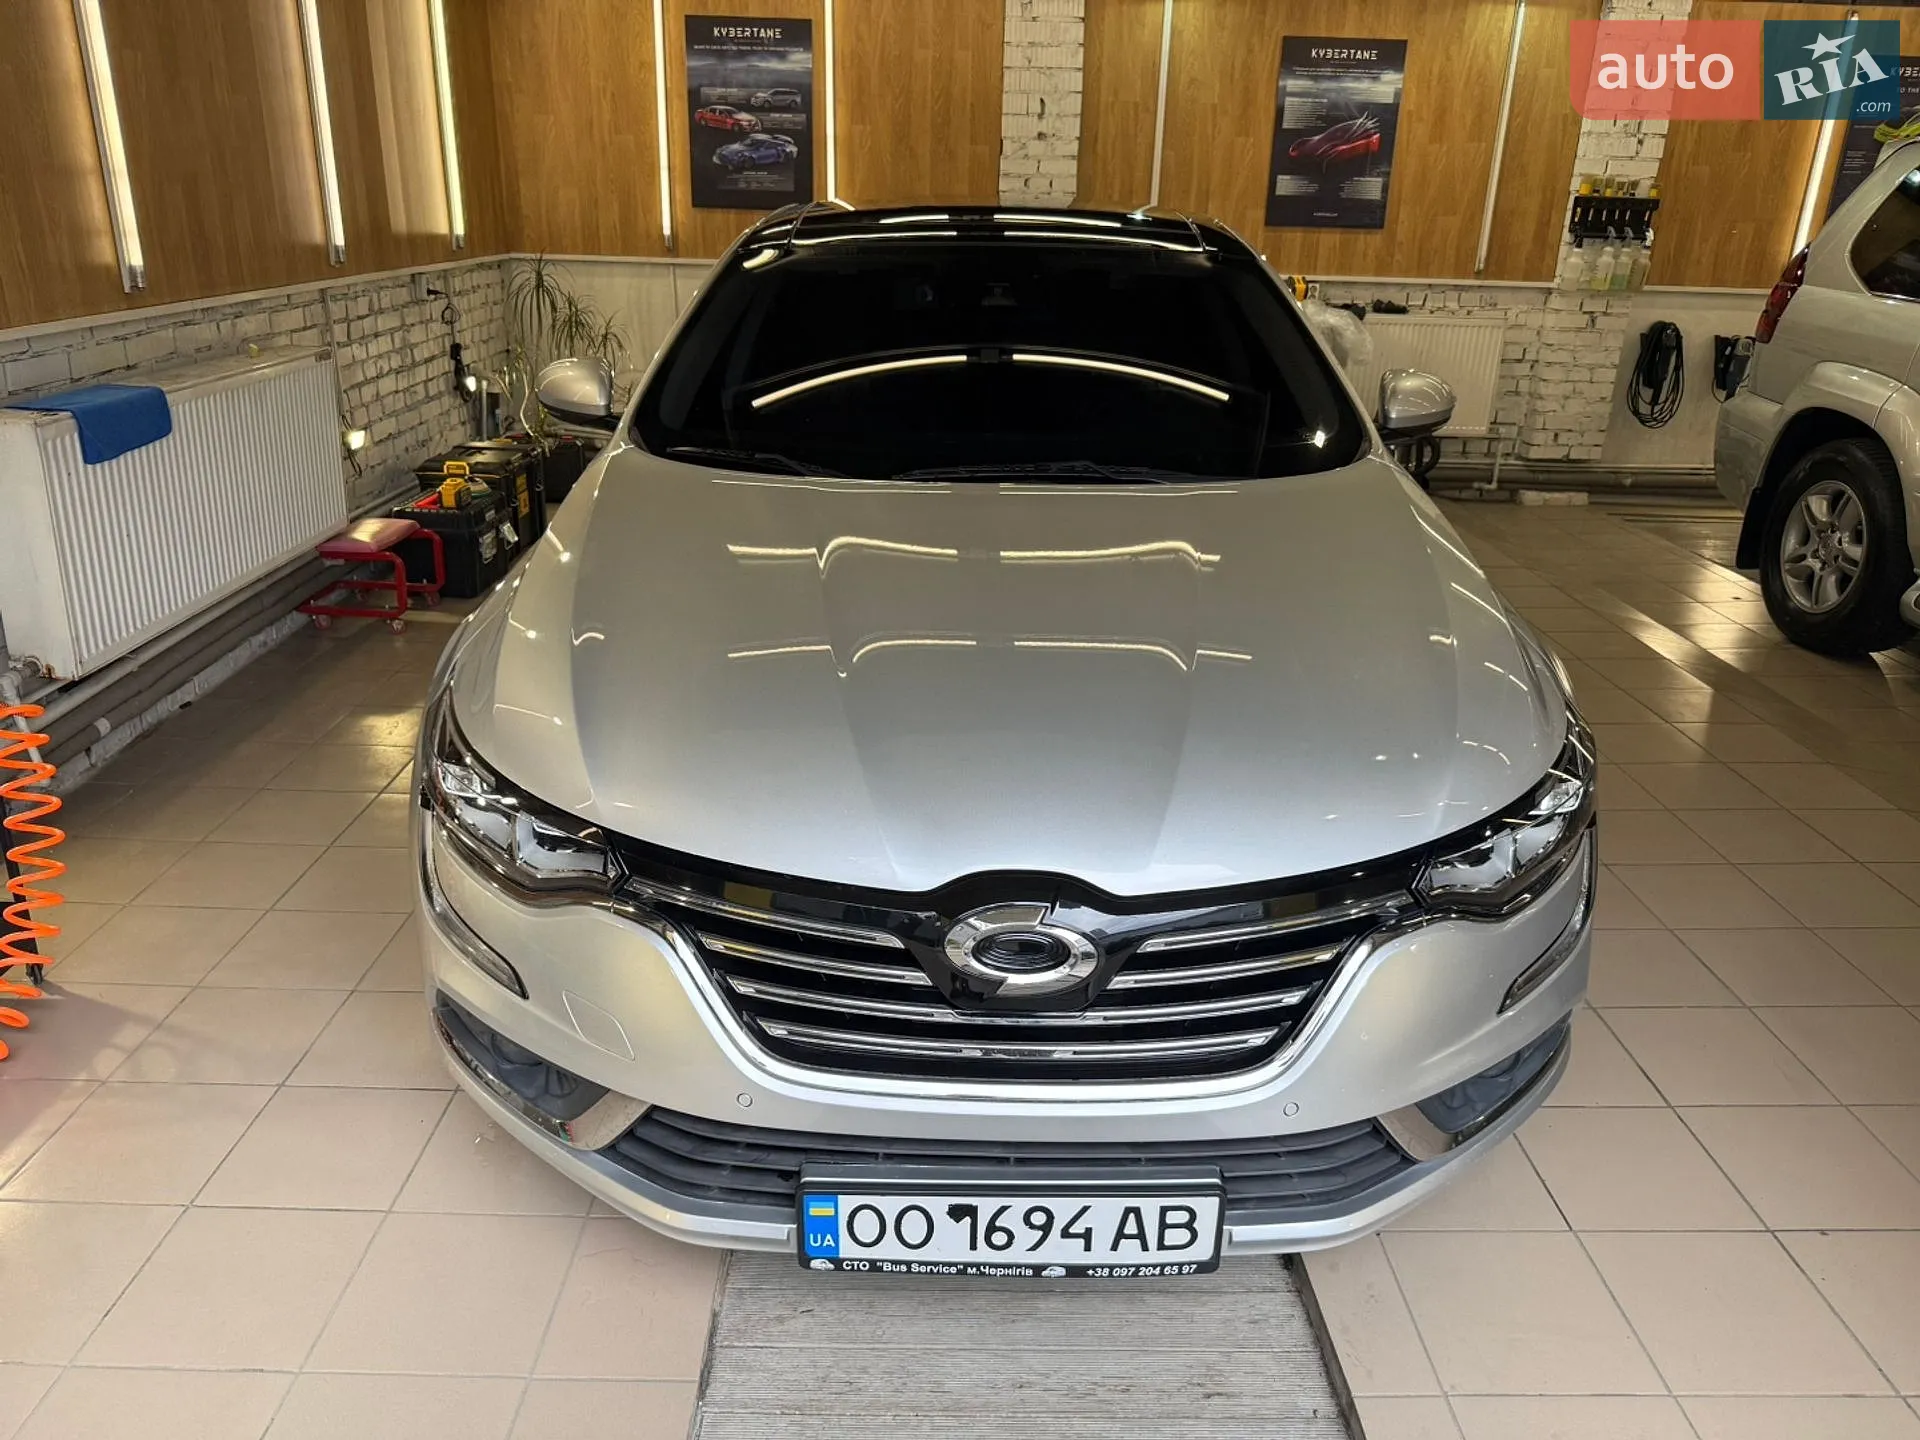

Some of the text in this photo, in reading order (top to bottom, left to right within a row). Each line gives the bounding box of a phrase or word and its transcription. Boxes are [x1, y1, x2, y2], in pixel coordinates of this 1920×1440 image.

[713, 27, 783, 38] KYBERTANE
[1311, 48, 1379, 60] KYBERTANE
[846, 1203, 1199, 1252] OO 1694 AB
[809, 1233, 836, 1247] UA
[842, 1260, 870, 1271] СТО
[876, 1261, 908, 1272] "Bus
[910, 1262, 964, 1274] Service"
[1086, 1267, 1110, 1277] +38
[1112, 1267, 1136, 1277] 097
[1138, 1266, 1161, 1276] 204
[1163, 1265, 1179, 1275] 65
[1181, 1263, 1198, 1274] 97
